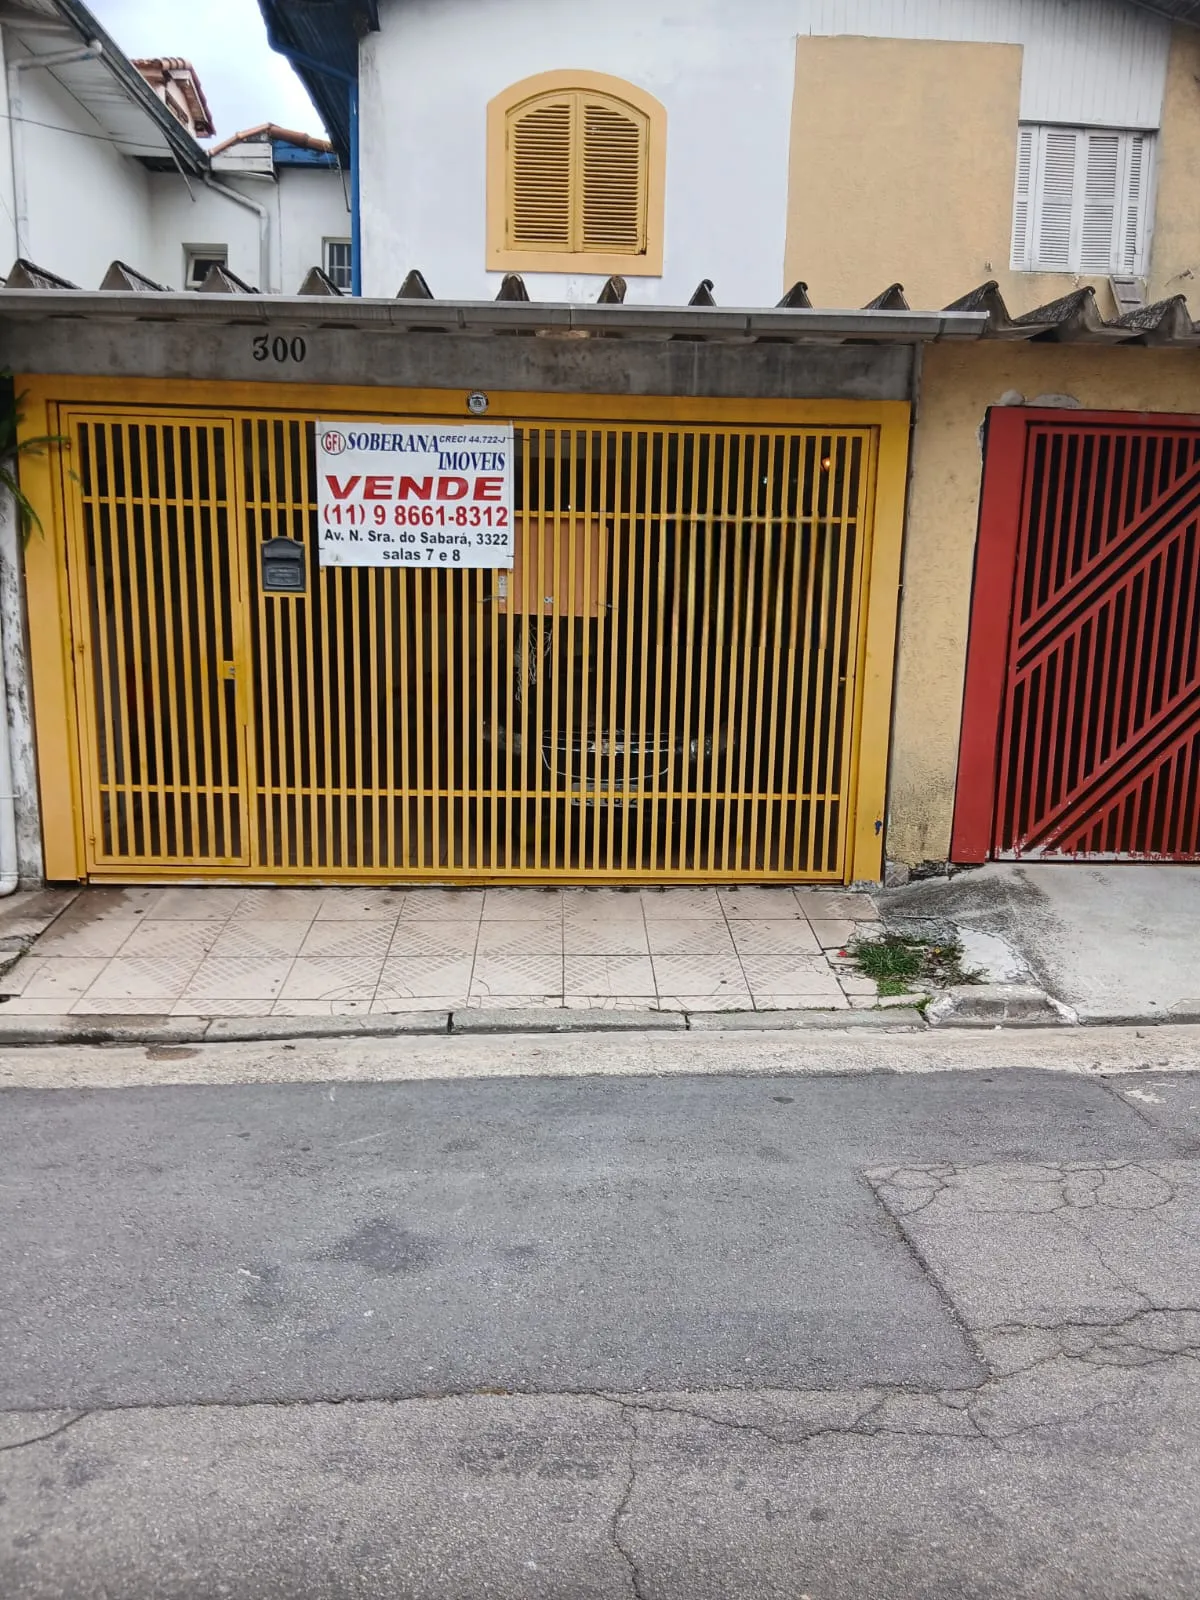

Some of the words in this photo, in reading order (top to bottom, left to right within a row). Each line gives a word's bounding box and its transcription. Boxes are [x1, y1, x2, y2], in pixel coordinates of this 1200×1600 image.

[253, 333, 306, 362] 300
[347, 432, 439, 453] SOBERANA
[440, 435, 466, 443] CRECI
[469, 435, 505, 444] 44.722-J
[438, 452, 505, 471] IMOVEIS
[325, 475, 504, 501] VENDE
[324, 504, 365, 525] (11)
[374, 505, 386, 526] 9
[394, 505, 508, 527] 8661-8312
[324, 530, 344, 541] Av.
[349, 530, 363, 541] N.
[368, 530, 394, 543] Sra.
[399, 531, 415, 543] do
[420, 532, 471, 547] Sabará,
[476, 533, 508, 546] 3322
[383, 548, 421, 561] salas
[425, 549, 434, 561] 7
[439, 552, 447, 561] e
[452, 549, 460, 562] 8
